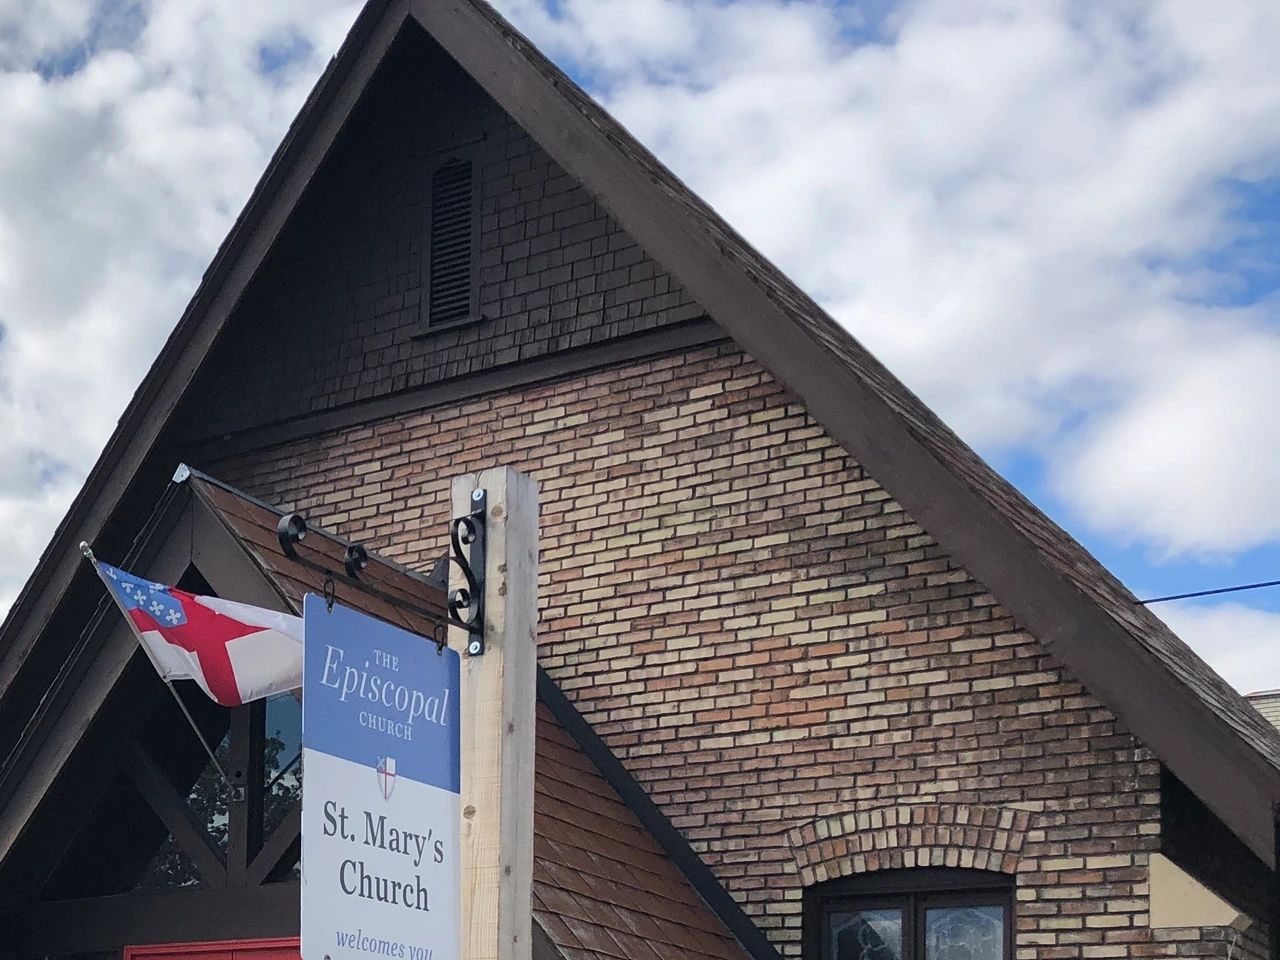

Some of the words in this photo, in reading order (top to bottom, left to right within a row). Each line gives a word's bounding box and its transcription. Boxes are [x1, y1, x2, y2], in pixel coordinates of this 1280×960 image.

[373, 649, 400, 672] THE
[319, 644, 450, 727] Episcopal
[359, 711, 413, 741] CHURCH
[322, 800, 356, 842] St.
[363, 811, 444, 868] Mary's
[339, 858, 430, 912] Church
[335, 928, 405, 959] welcomes
